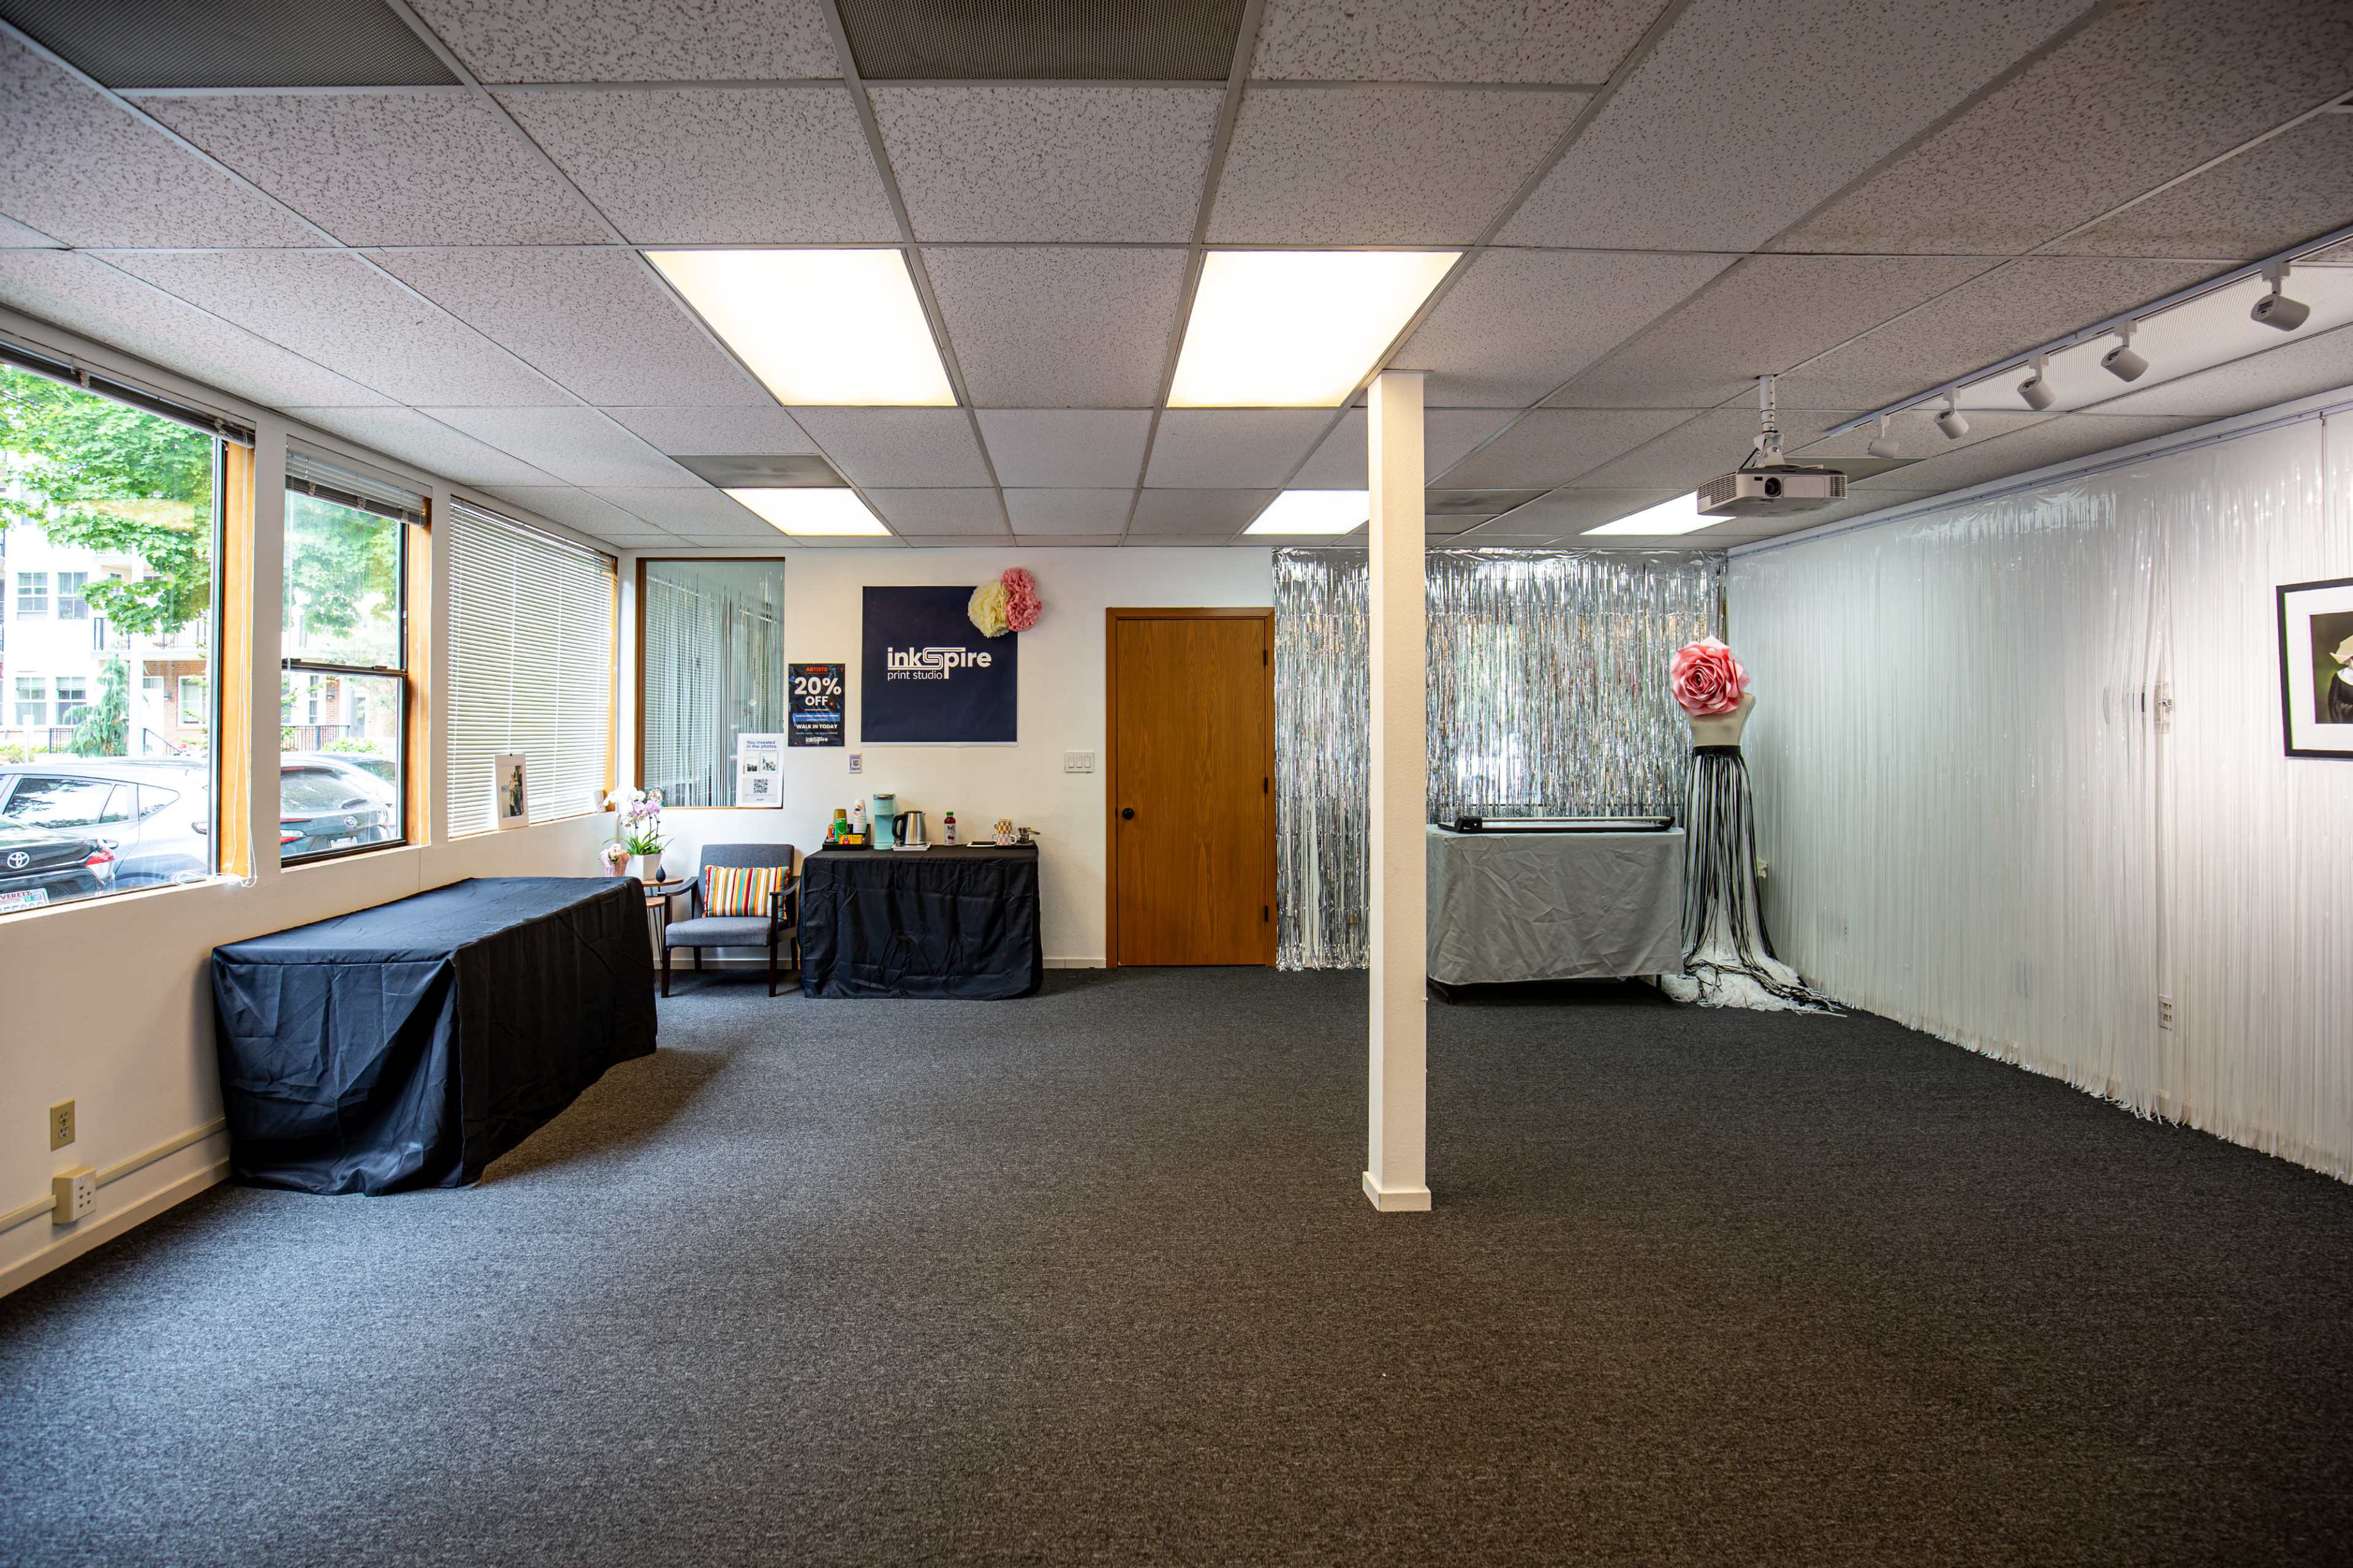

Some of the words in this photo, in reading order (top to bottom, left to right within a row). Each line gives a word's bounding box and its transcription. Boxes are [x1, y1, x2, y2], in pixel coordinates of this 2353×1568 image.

[887, 670, 911, 681] print
[913, 670, 942, 680] studio
[794, 676, 842, 695] 20%
[805, 695, 828, 706] OFF
